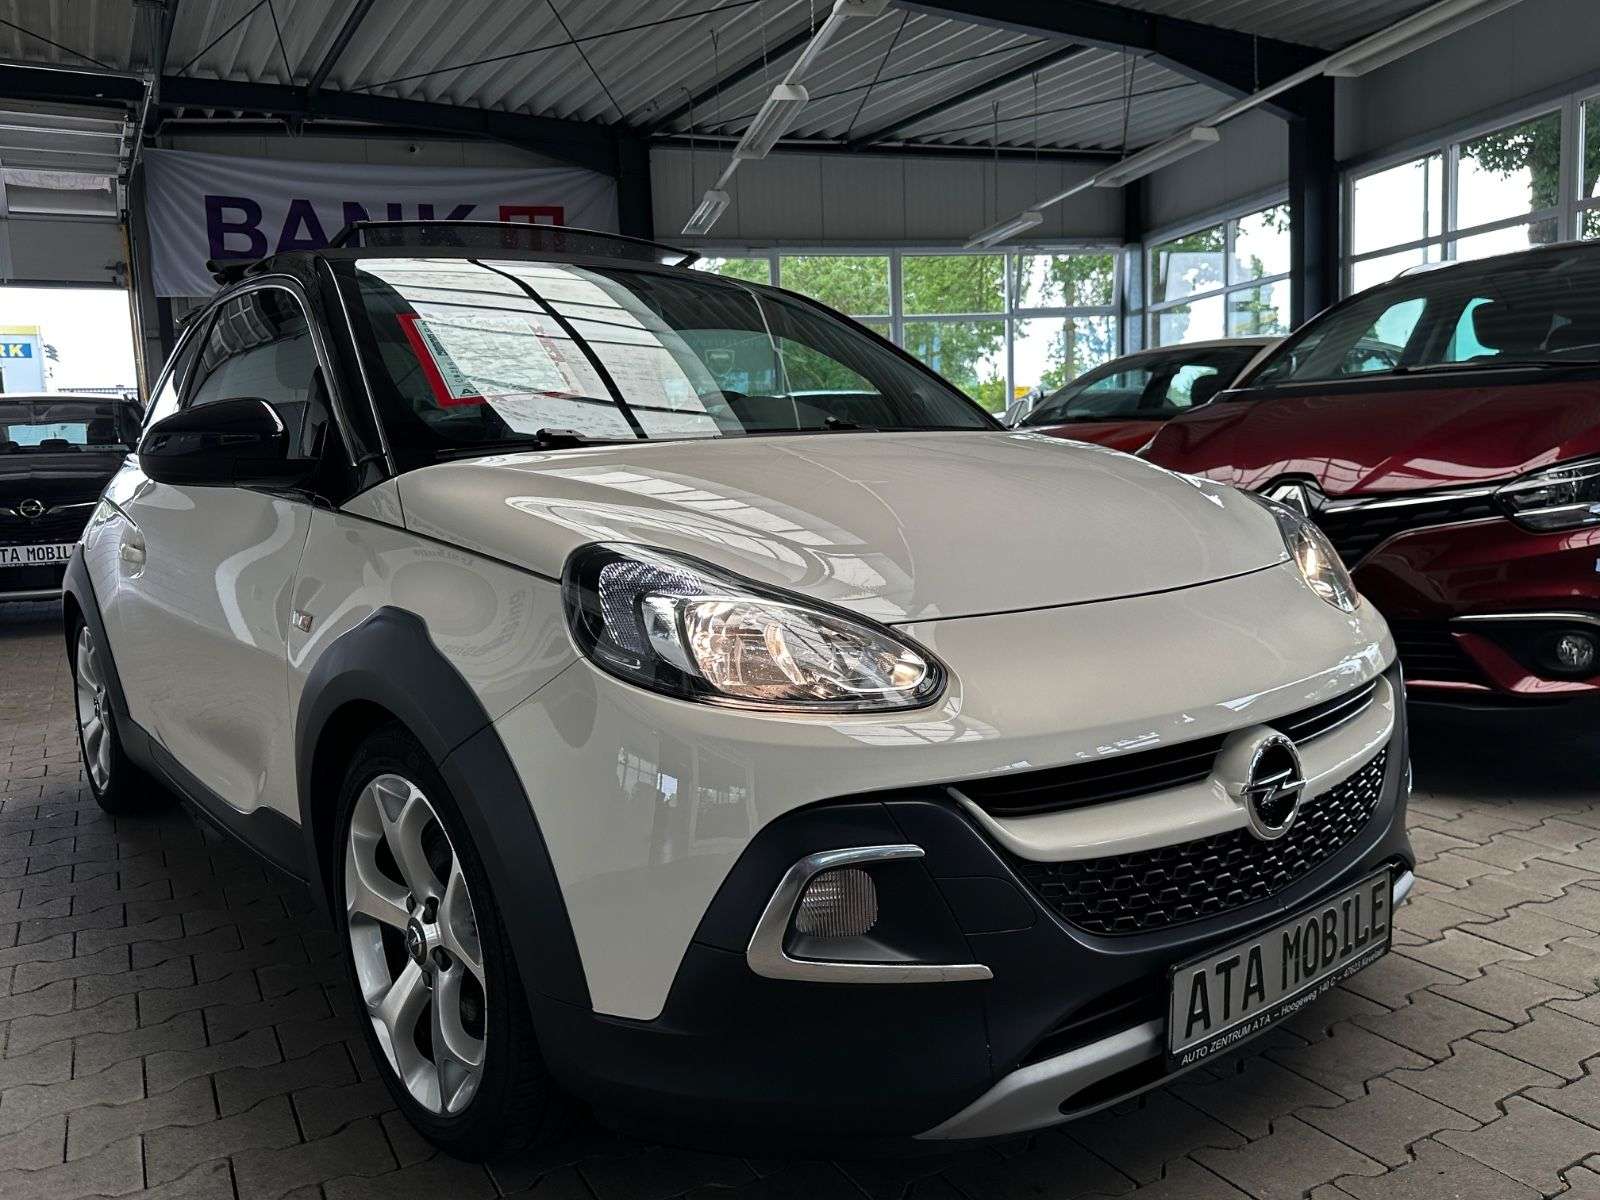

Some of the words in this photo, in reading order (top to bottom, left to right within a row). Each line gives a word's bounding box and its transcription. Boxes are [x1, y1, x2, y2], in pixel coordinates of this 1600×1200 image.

[26, 545, 76, 561] MOBIL
[1184, 944, 1266, 1038] ATA
[1281, 880, 1386, 990] MOBILE
[1181, 1045, 1208, 1066] AUTO
[1210, 1023, 1251, 1053] ZENTRUM
[1252, 1013, 1271, 1031] ATA
